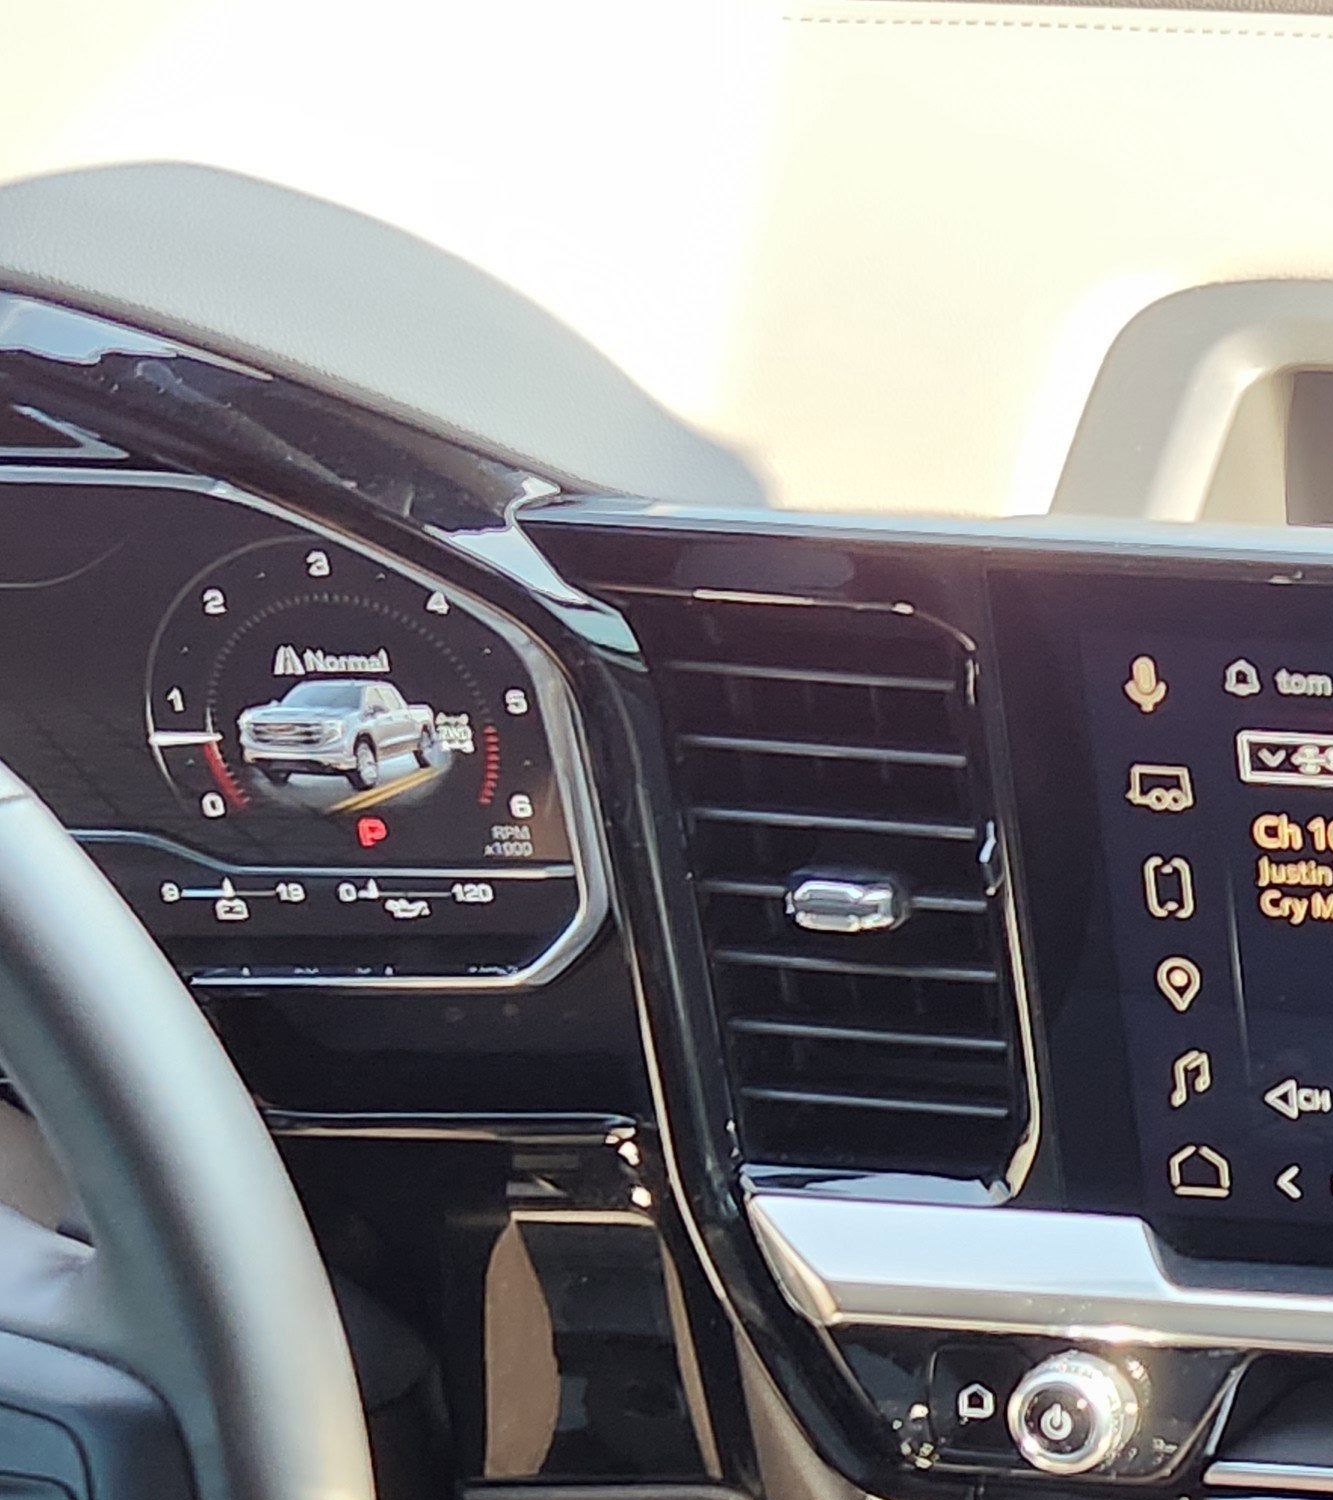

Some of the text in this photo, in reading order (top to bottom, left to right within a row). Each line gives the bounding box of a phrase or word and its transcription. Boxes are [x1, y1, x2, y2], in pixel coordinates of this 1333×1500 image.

[306, 553, 331, 576] 3
[202, 590, 226, 615] 2
[426, 591, 449, 615] 4
[303, 648, 390, 672] Normal
[1275, 668, 1333, 696] tom
[167, 688, 184, 712] 1
[506, 689, 528, 714] 5
[202, 793, 225, 817] 0
[510, 795, 533, 818] 6
[358, 818, 386, 846] P
[491, 825, 531, 840] RPM
[1253, 813, 1302, 850] Ch
[1257, 856, 1333, 887] Justin
[338, 883, 356, 901] 0
[451, 884, 494, 902] 120
[1260, 889, 1308, 925] Cry
[1298, 1088, 1331, 1113] CH
